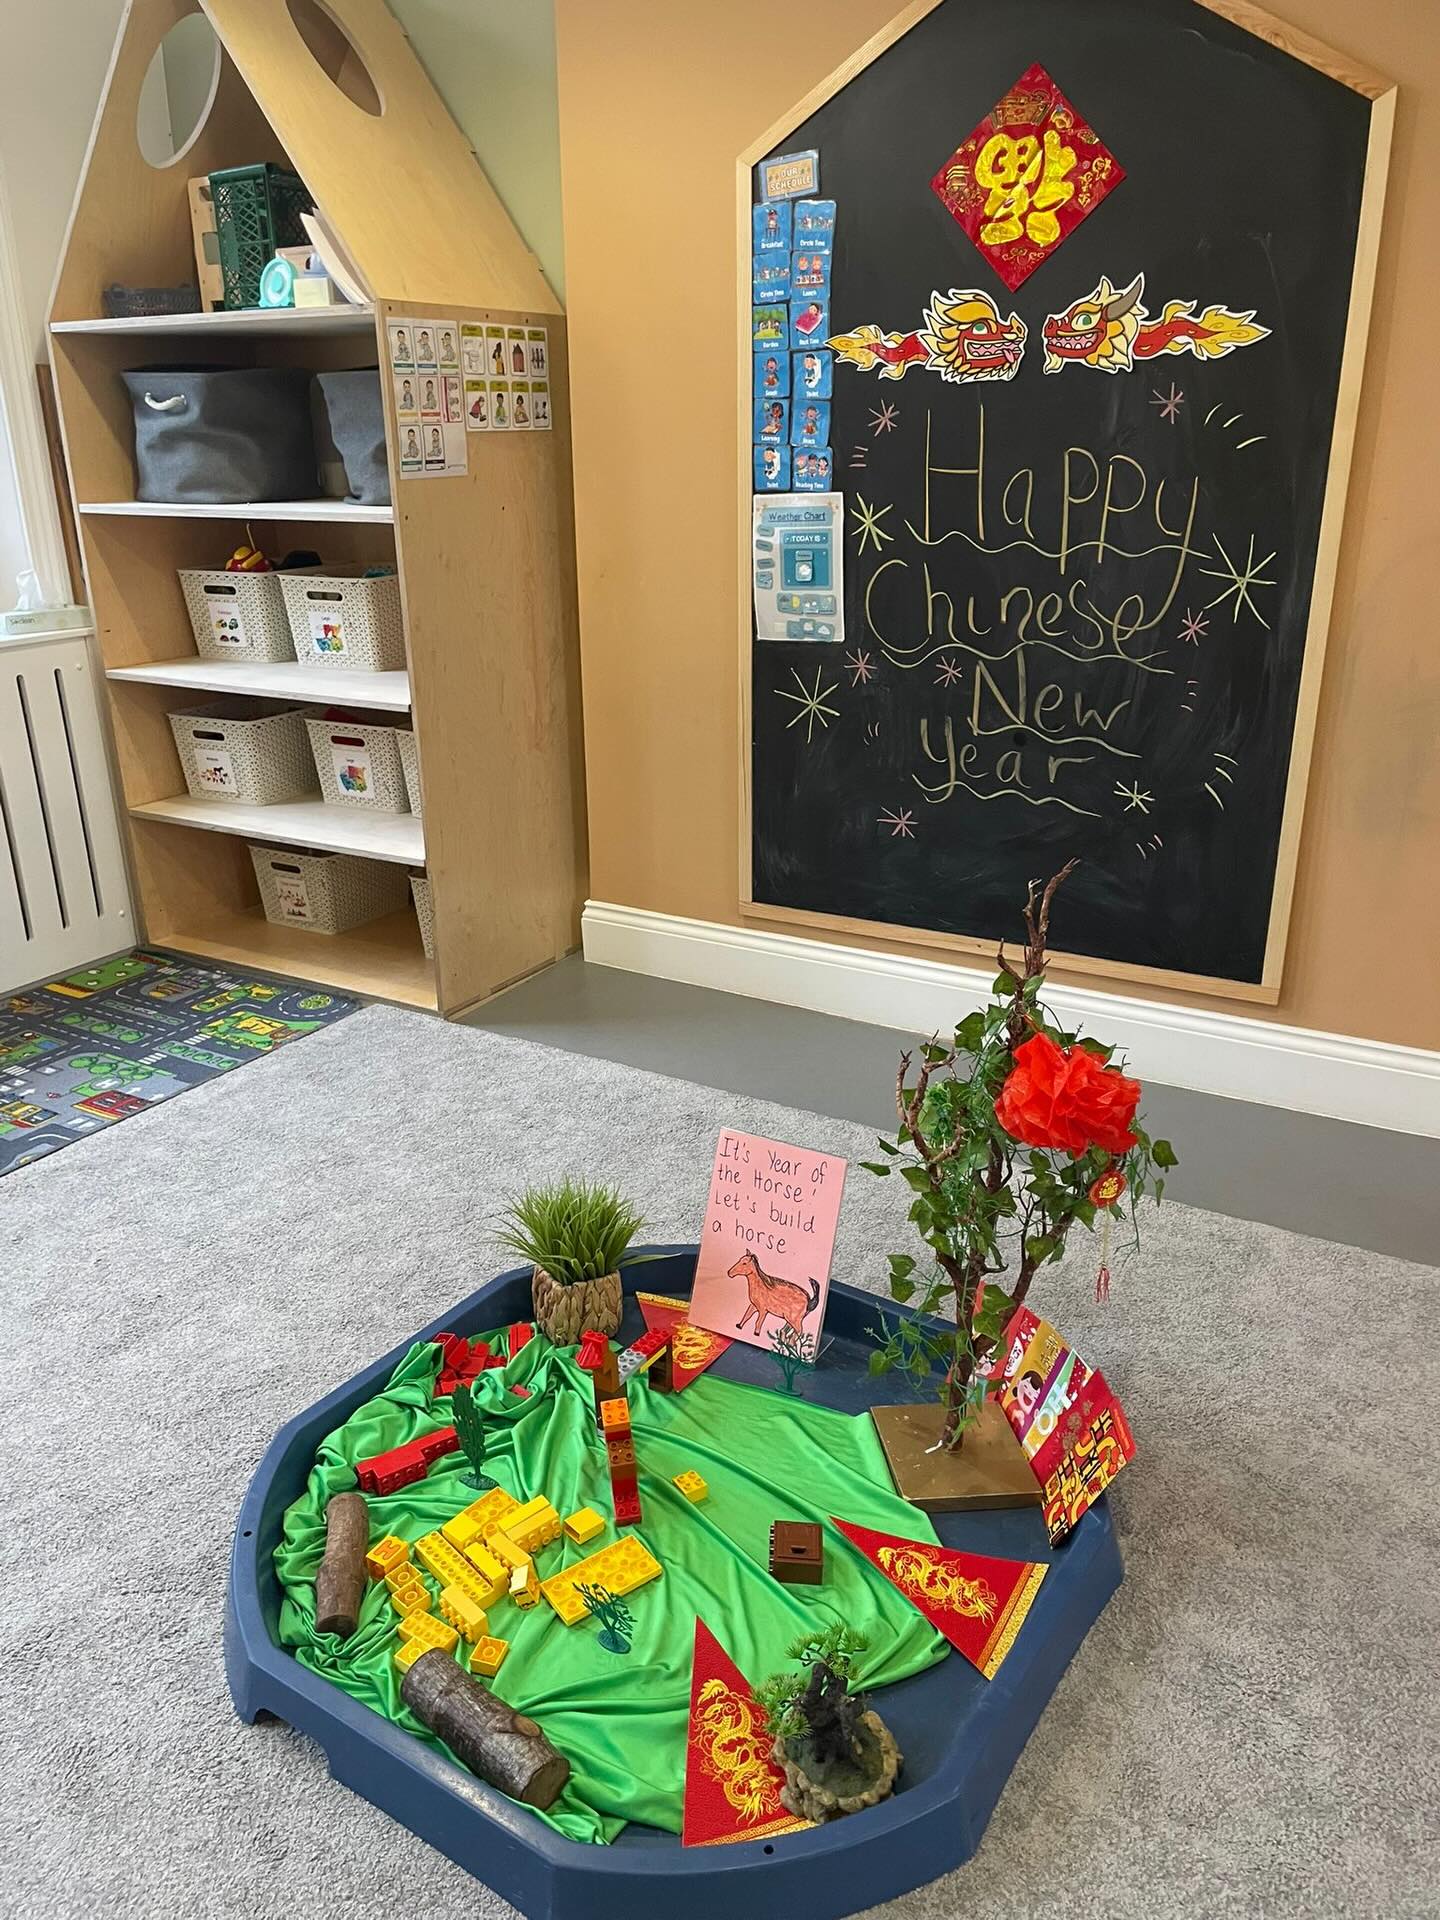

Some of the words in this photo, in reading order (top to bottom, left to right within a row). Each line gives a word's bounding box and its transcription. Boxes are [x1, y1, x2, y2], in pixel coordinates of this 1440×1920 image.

[770, 176, 812, 192] SCHEDULE
[768, 512, 802, 521] Weather
[804, 511, 826, 521] Chart
[926, 404, 1199, 631] Happy
[791, 535, 813, 543] TODAY
[866, 559, 1169, 662] Chinese
[969, 648, 1131, 736] New
[717, 1163, 742, 1184] the
[719, 1136, 751, 1164] It's
[767, 1150, 802, 1176] Year
[811, 1161, 828, 1184] of
[712, 1219, 722, 1233] a
[769, 1201, 816, 1234] build
